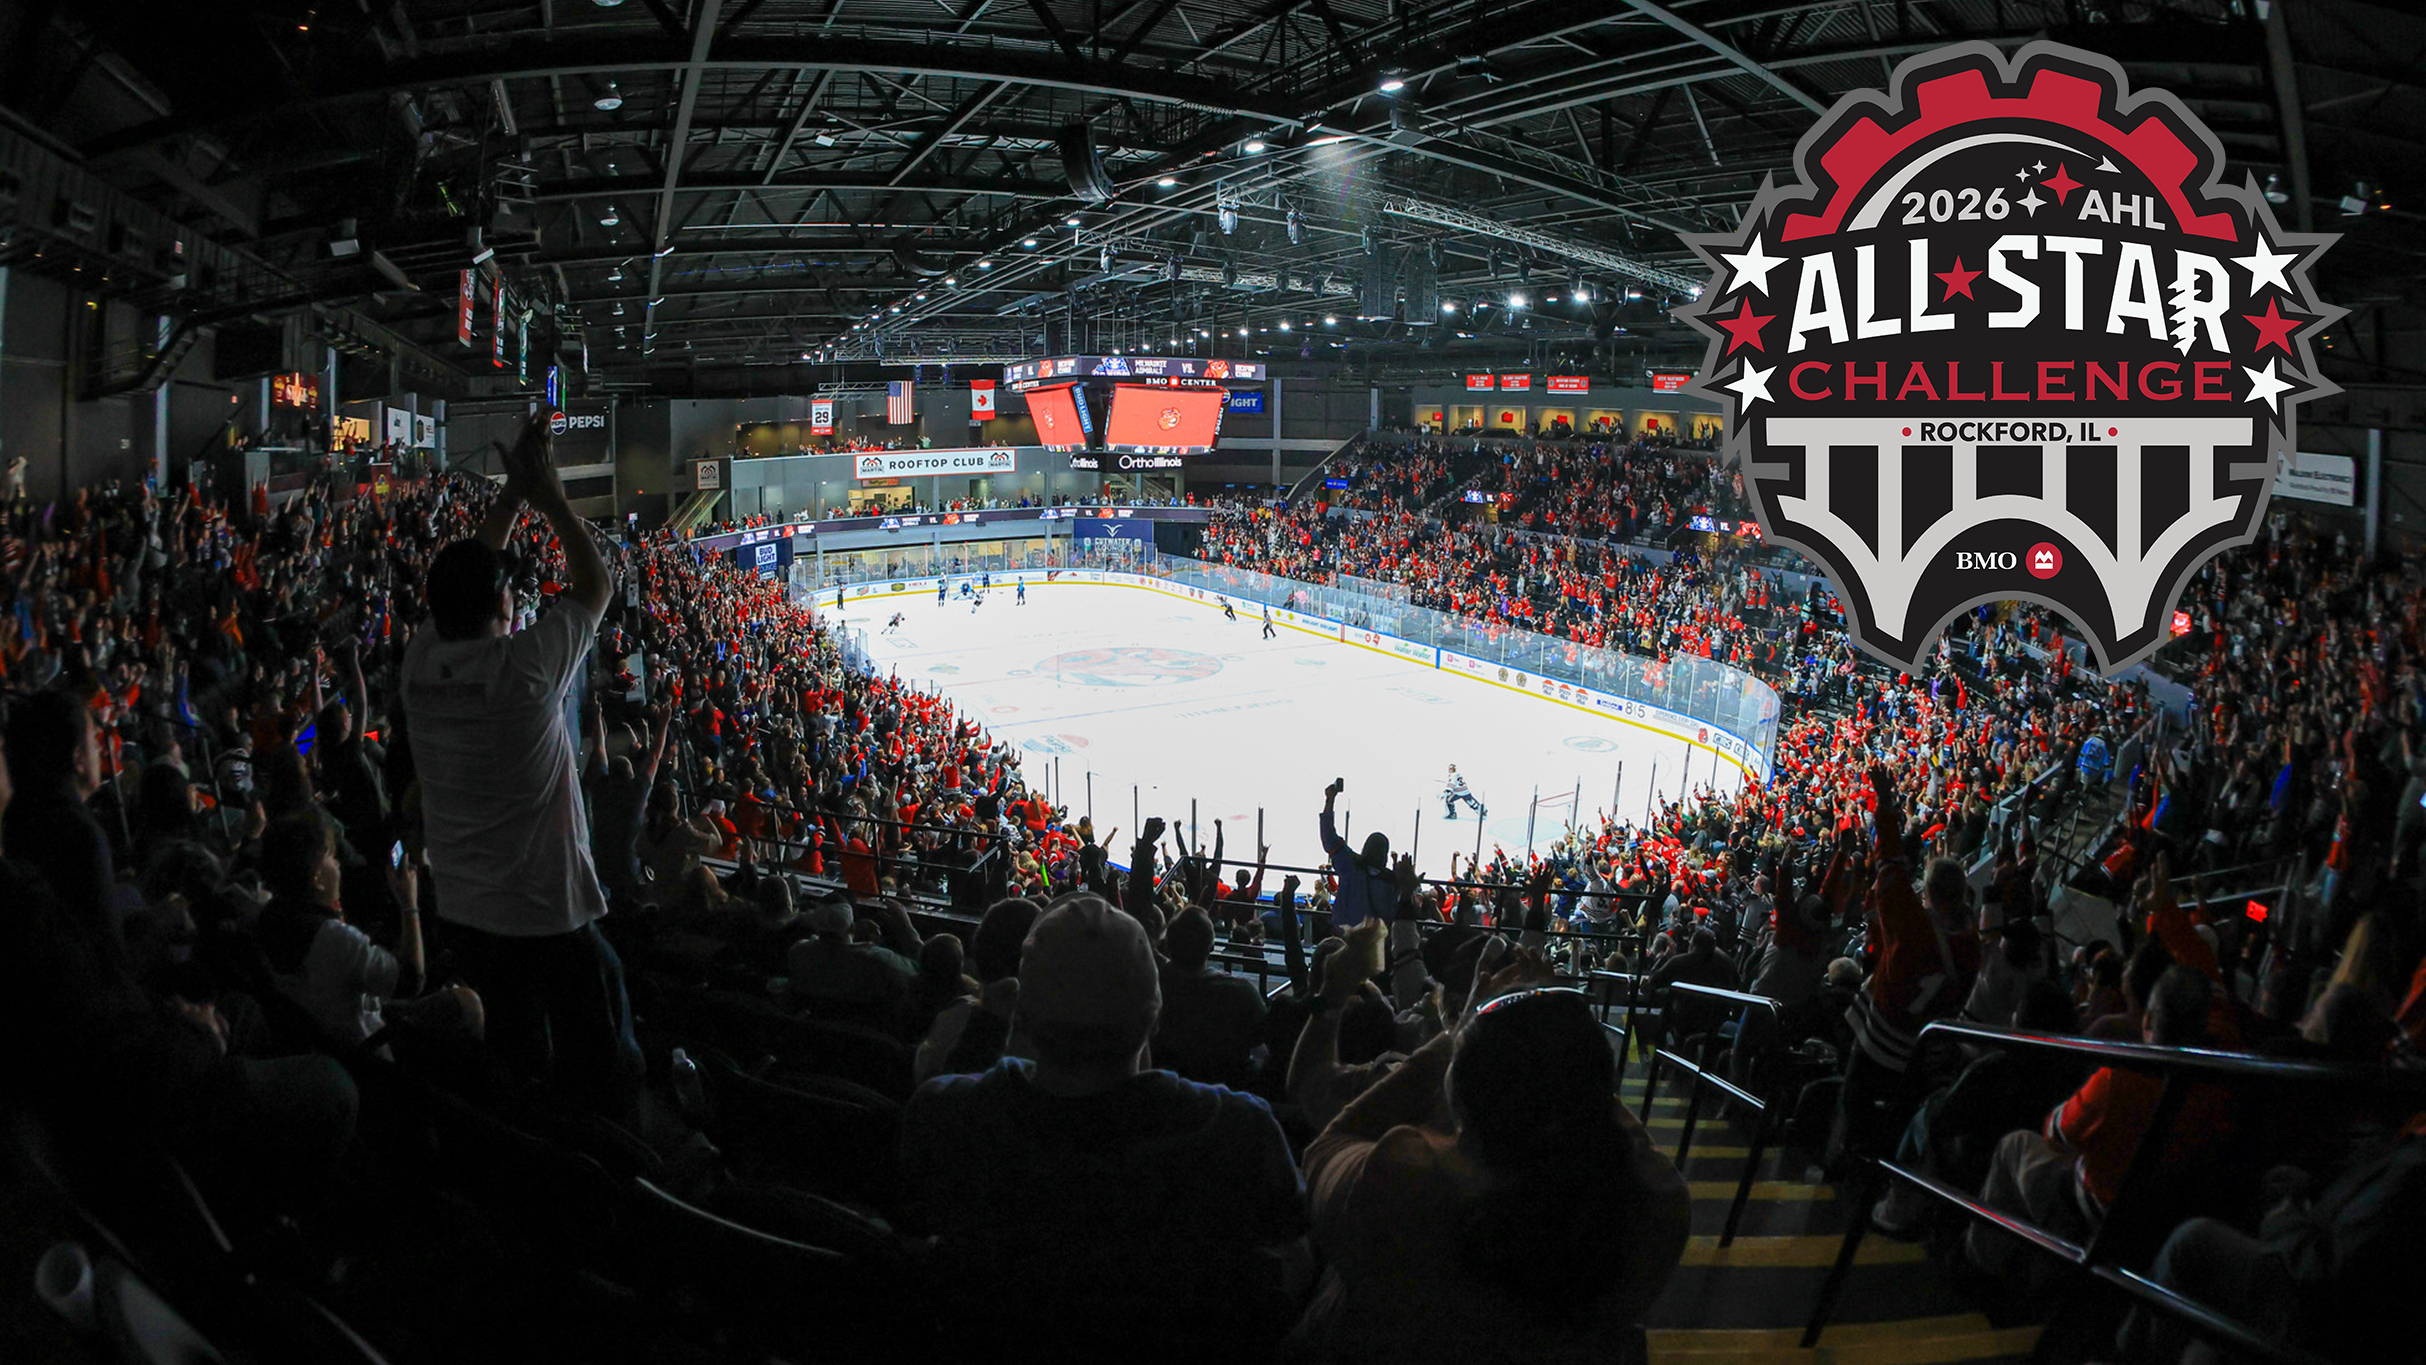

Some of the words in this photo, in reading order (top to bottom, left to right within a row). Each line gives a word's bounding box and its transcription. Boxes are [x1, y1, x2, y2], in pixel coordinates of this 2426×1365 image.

[1181, 378, 1217, 386] CENTER
[1231, 398, 1258, 408] IGHT
[569, 416, 604, 429] PEPSI
[815, 411, 829, 423] 29
[889, 459, 948, 470] ROOFTOP
[953, 457, 984, 467] CLUB
[1119, 455, 1182, 469] OrthoIllinois
[760, 546, 773, 555] BUD
[757, 553, 775, 564] LIGHT
